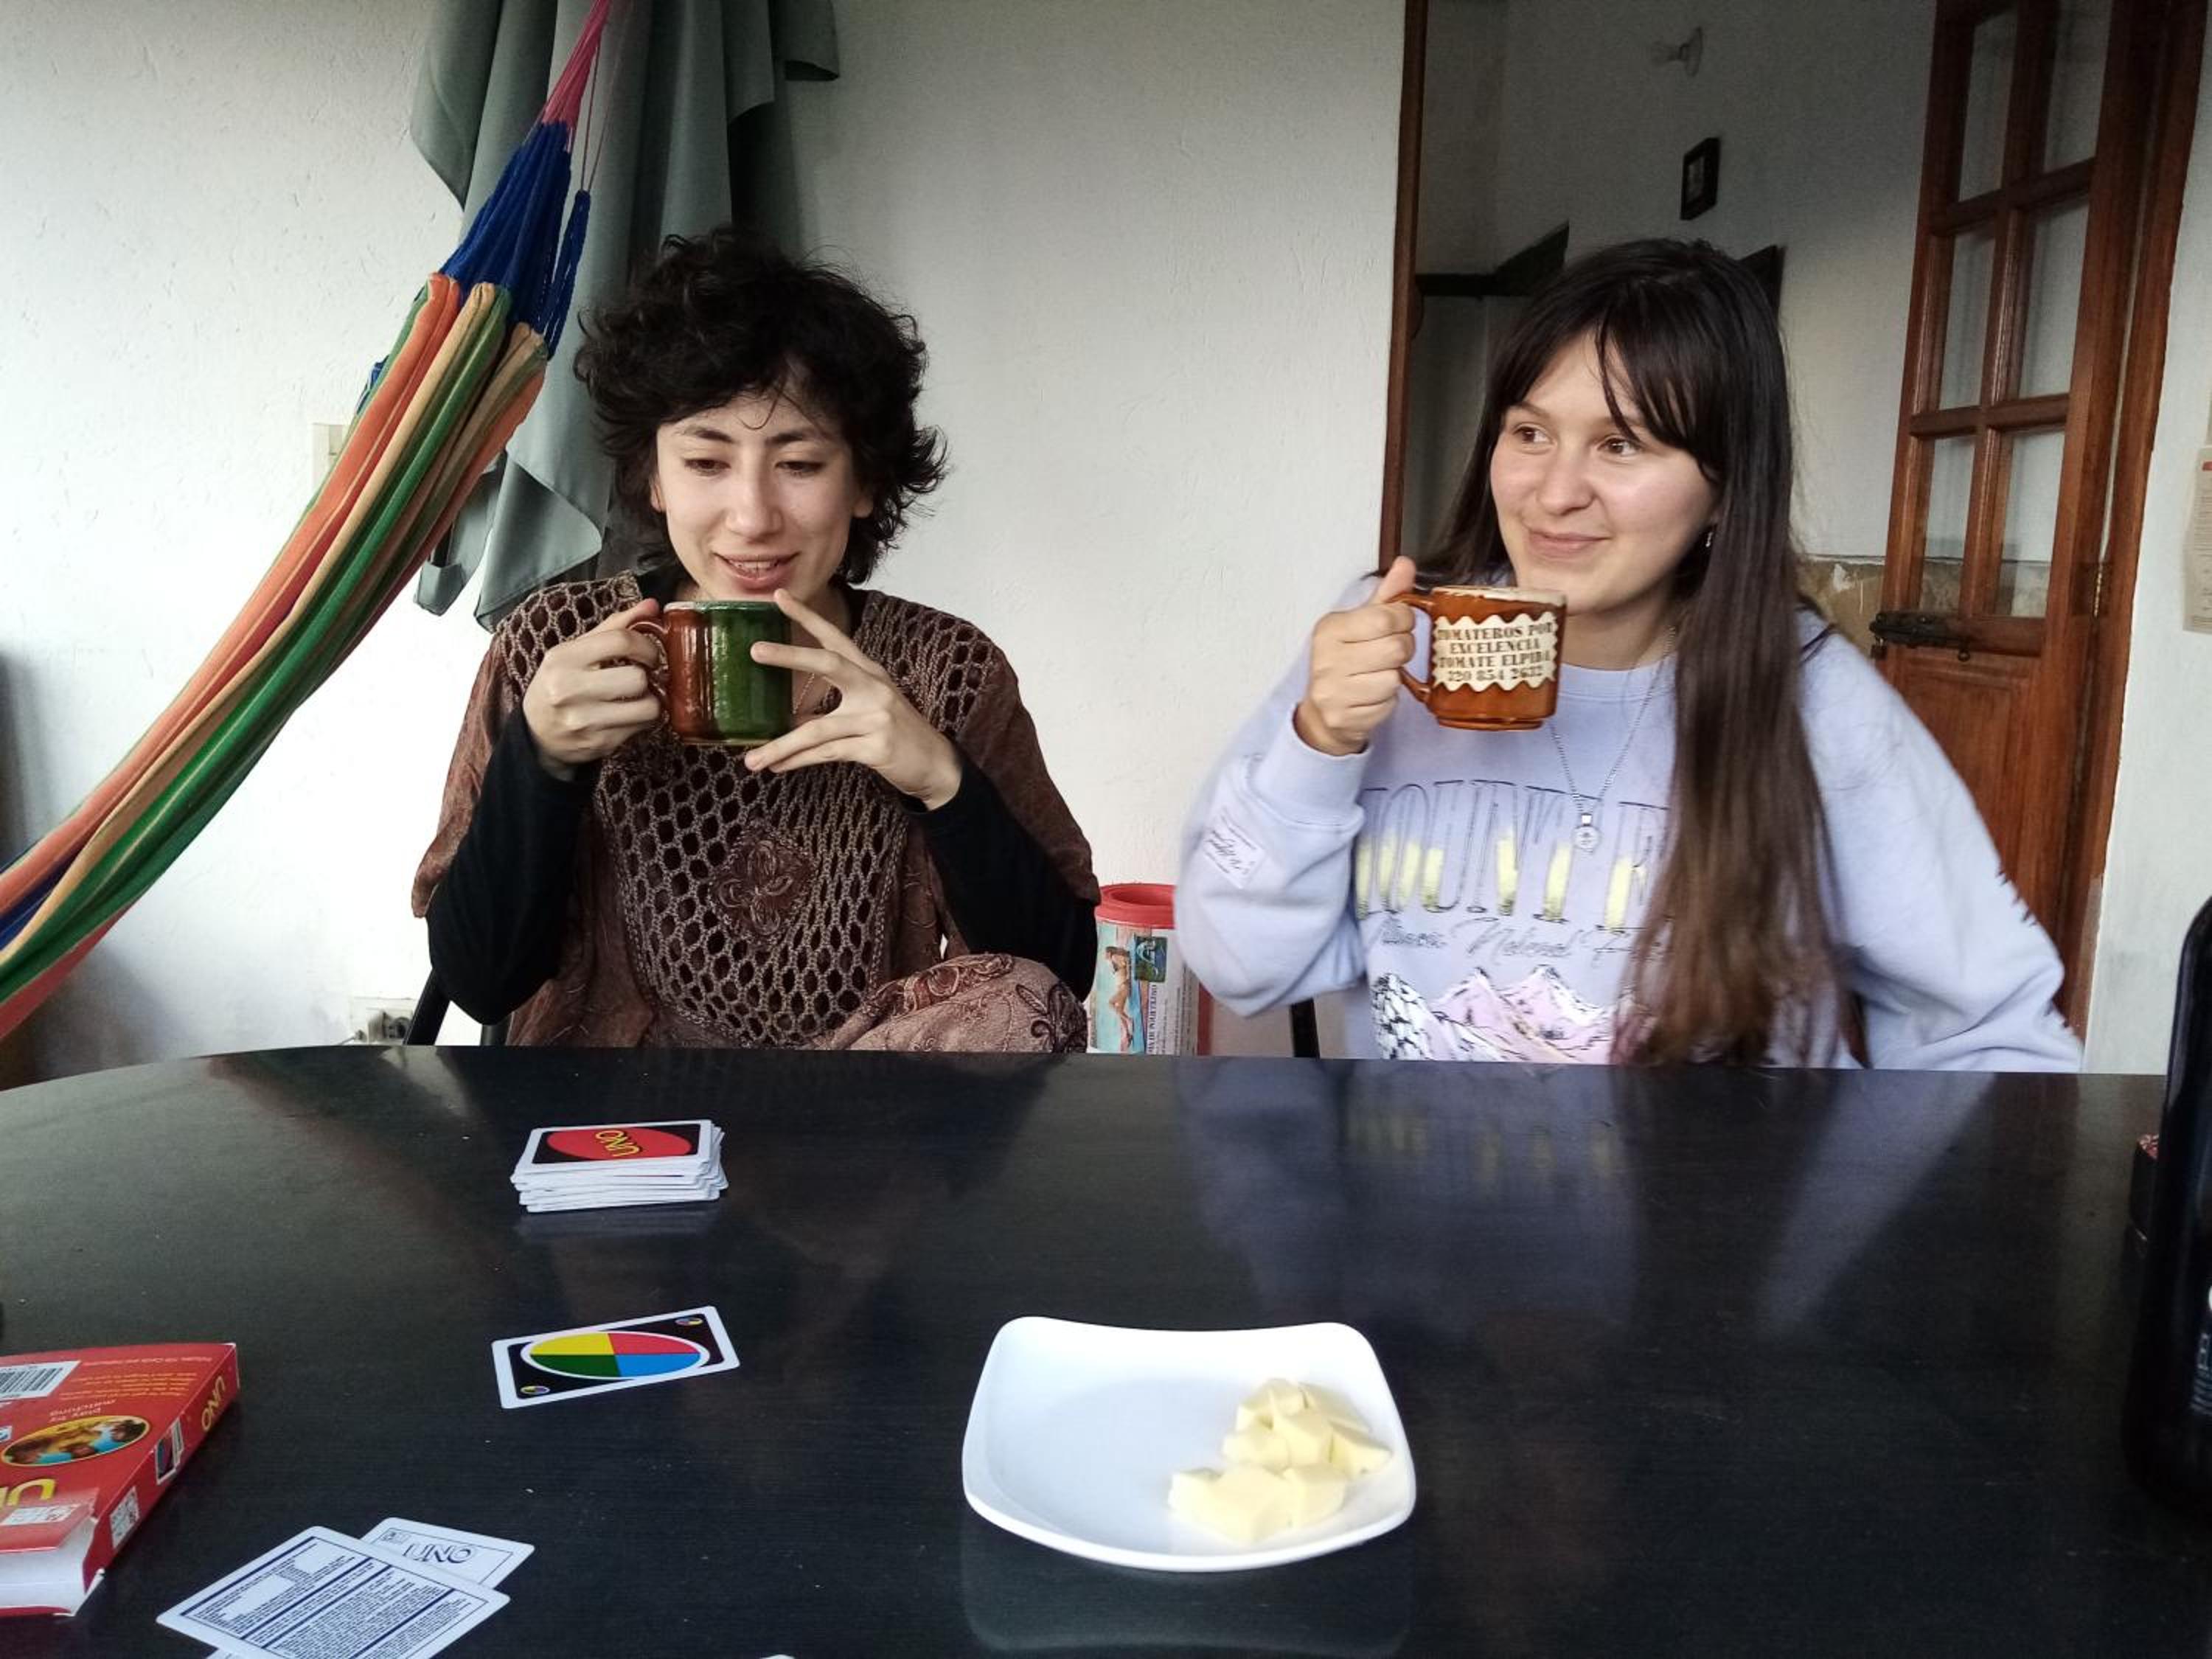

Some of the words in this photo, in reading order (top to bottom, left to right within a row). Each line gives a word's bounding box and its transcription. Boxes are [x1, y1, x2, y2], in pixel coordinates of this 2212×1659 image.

[596, 1130, 639, 1157] UNO
[201, 1376, 225, 1431] UNO
[403, 1544, 476, 1564] UNO
